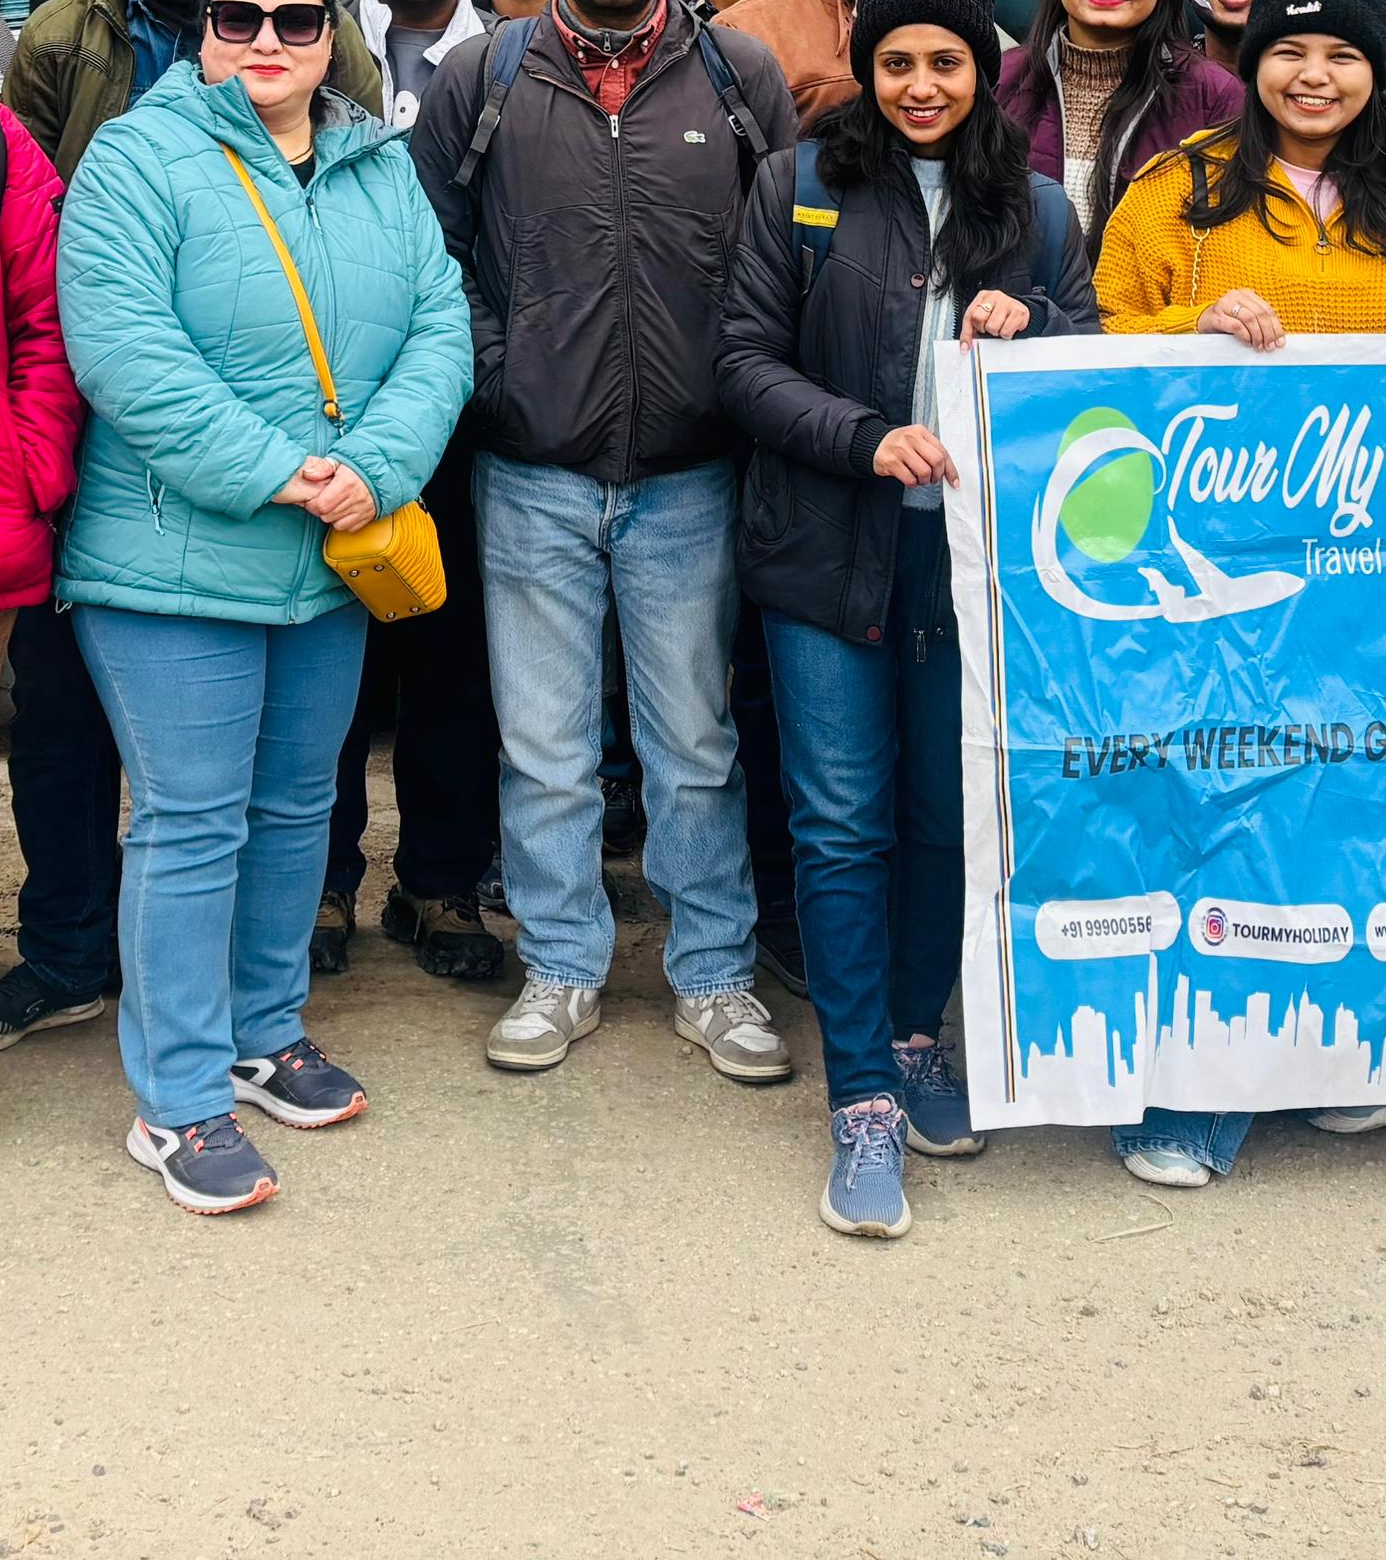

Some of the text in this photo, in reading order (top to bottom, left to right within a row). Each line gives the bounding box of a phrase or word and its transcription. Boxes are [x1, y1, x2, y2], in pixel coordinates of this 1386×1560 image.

[1162, 403, 1279, 511] Tour
[1283, 403, 1385, 538] My
[1302, 537, 1381, 575] Travel
[1061, 731, 1175, 779] EVERY
[1183, 723, 1354, 771] WEEKEND
[1061, 921, 1083, 938] +91
[1232, 923, 1349, 944] TOURMYHOLIDAY
